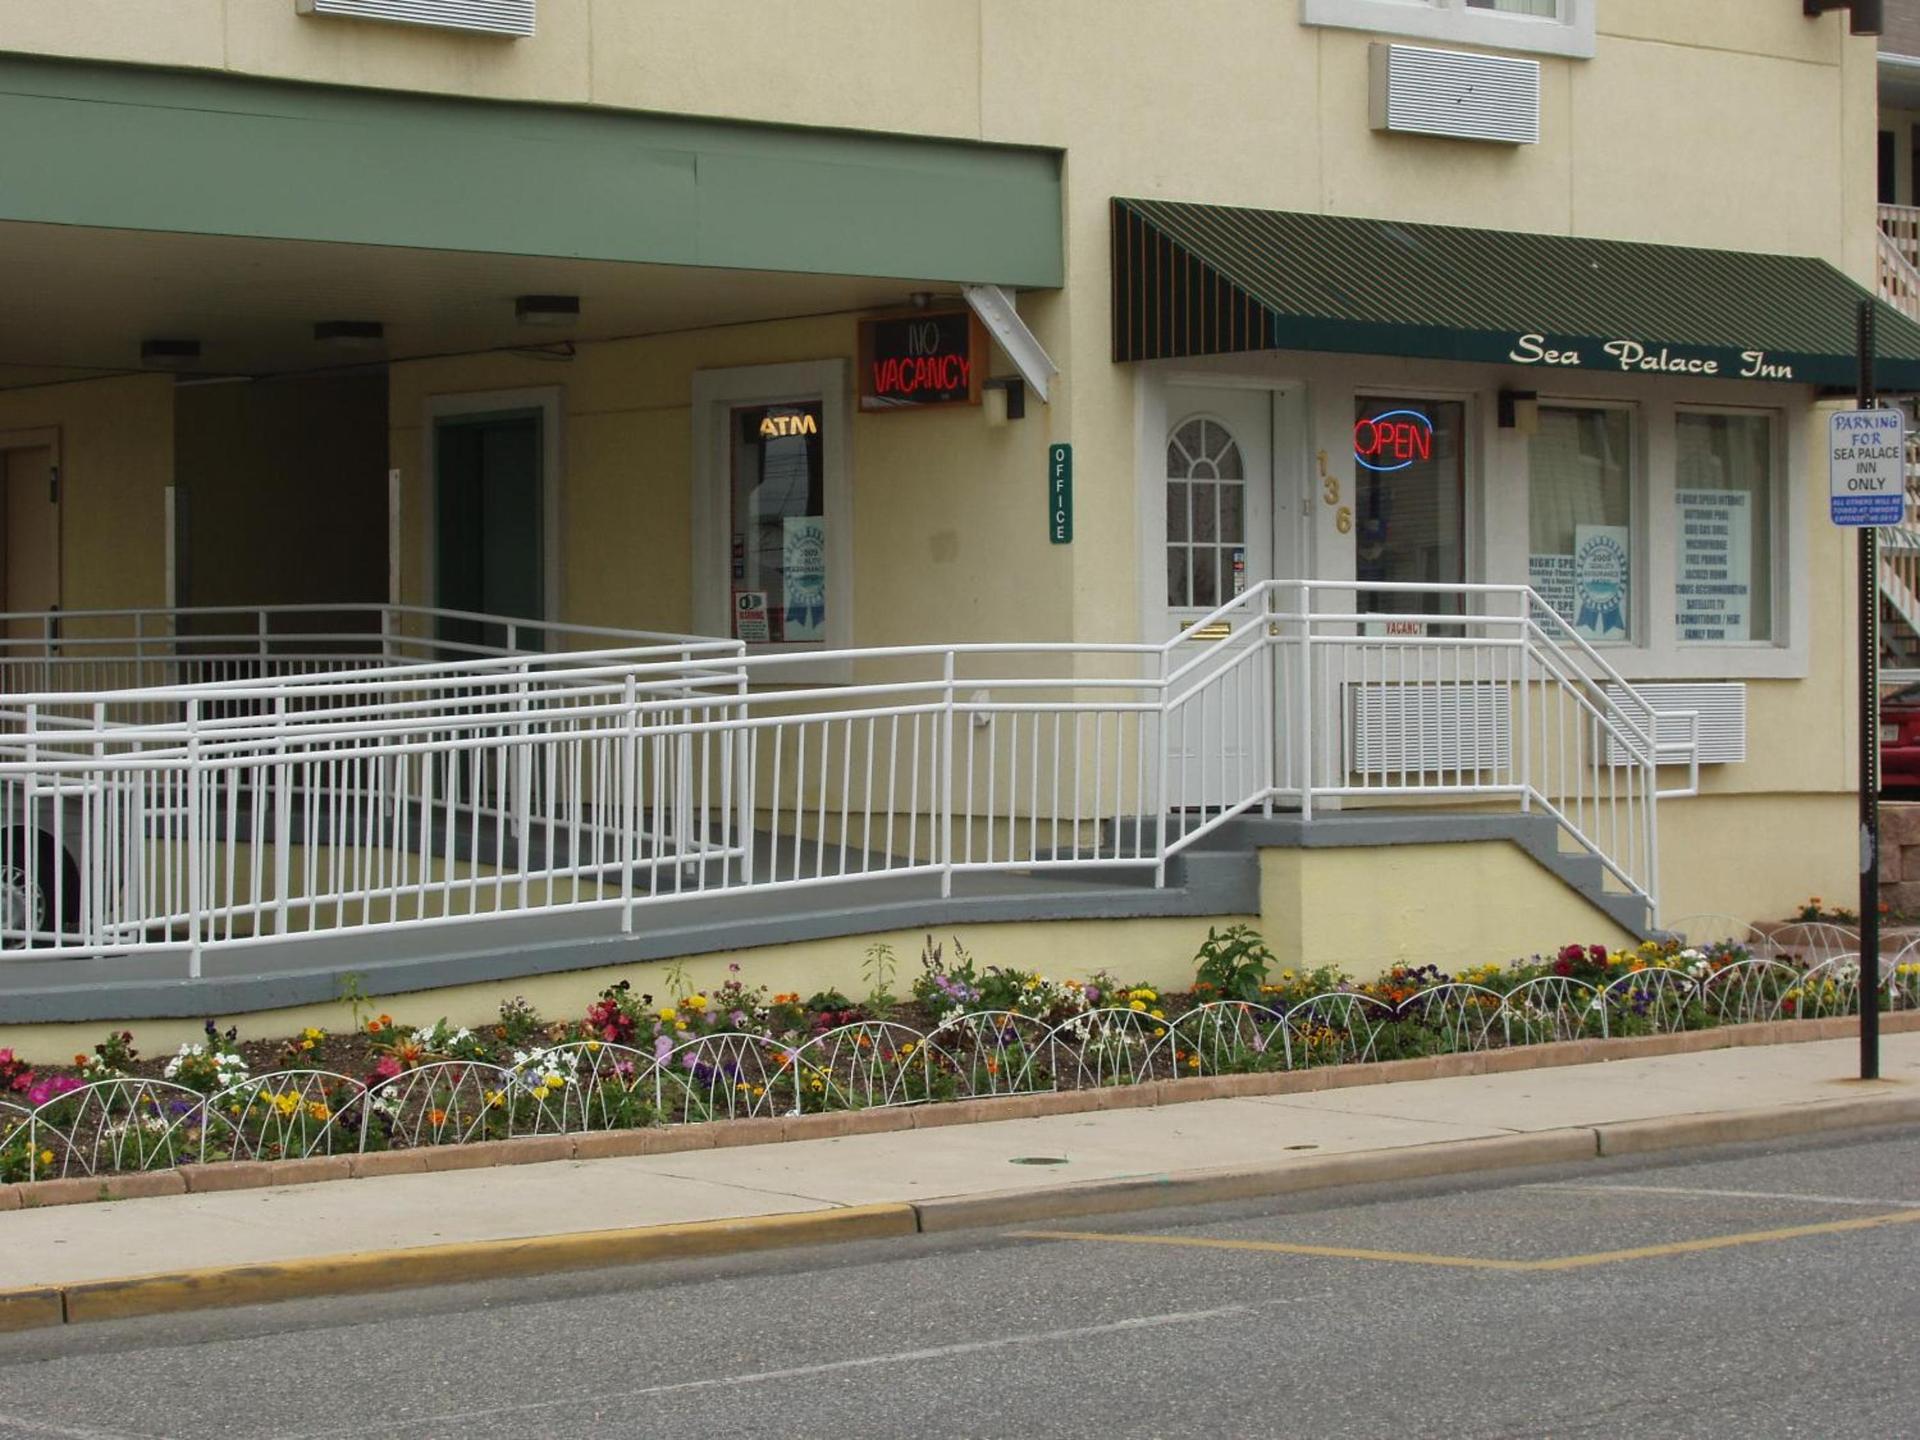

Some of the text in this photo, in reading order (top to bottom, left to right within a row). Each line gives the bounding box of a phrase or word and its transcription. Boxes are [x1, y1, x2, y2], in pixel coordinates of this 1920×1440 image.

[909, 321, 939, 355] NO
[1509, 333, 1793, 379] Sea Palace Inn
[873, 355, 972, 394] VACANCY
[760, 414, 817, 436] ATM
[1835, 415, 1898, 430] PARKING
[1354, 419, 1432, 460] OPEN
[1852, 432, 1882, 446] FOR
[1834, 446, 1899, 460] SEA PALACE
[1856, 462, 1877, 474] INN
[1055, 448, 1065, 539] OFFICE
[1848, 478, 1886, 491] ONLY
[1386, 621, 1423, 635] VACANCY
